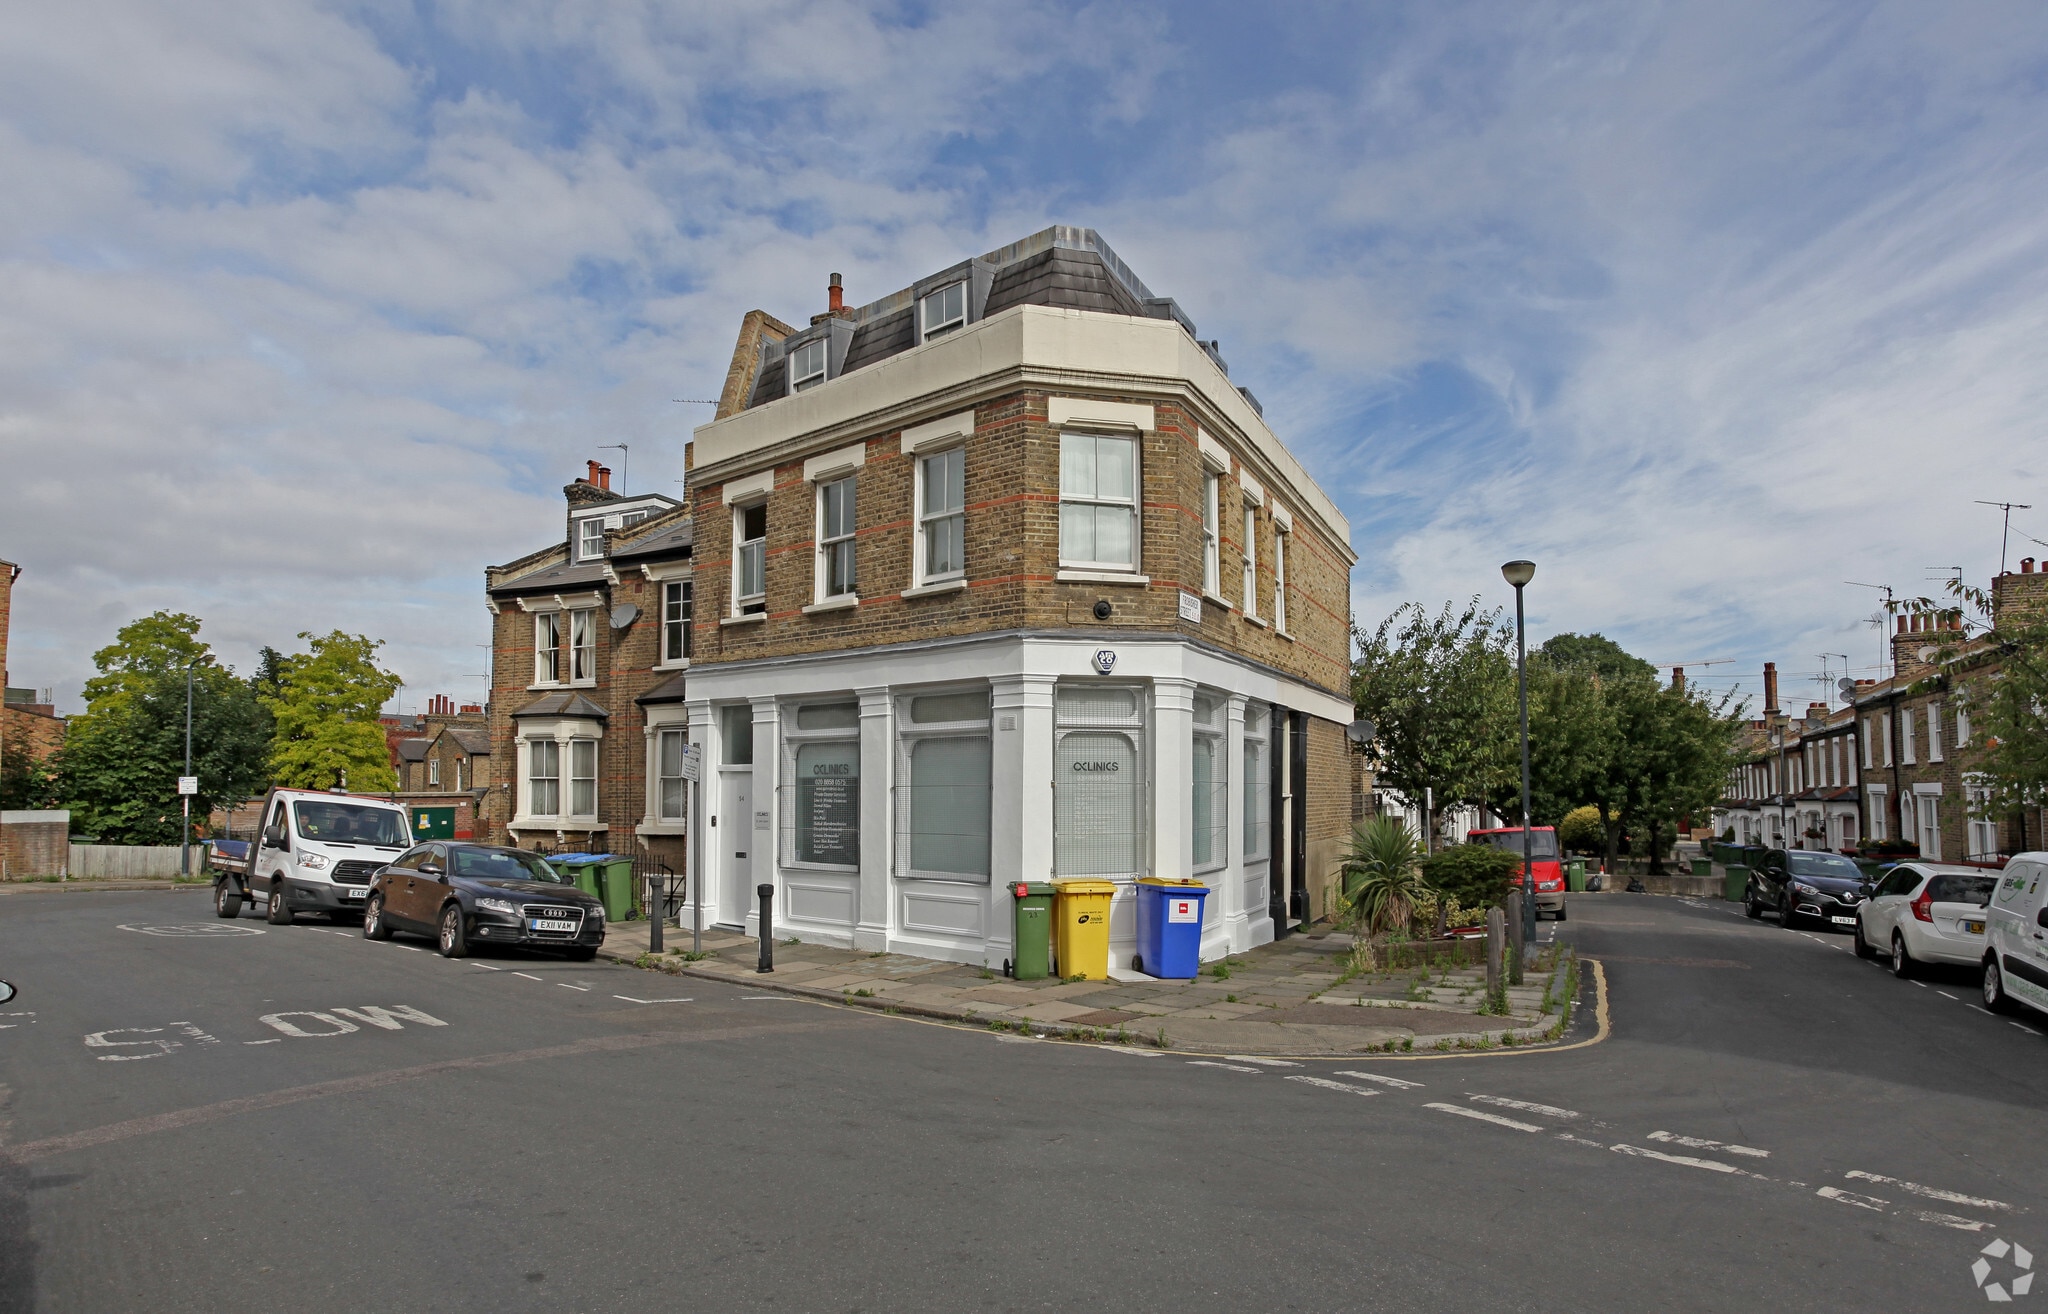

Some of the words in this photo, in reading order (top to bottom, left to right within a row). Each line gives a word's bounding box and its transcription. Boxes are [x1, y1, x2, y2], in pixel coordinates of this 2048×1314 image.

[557, 922, 572, 930] VAM
[1971, 924, 1984, 932] LX
[84, 1004, 450, 1061] SLOW
